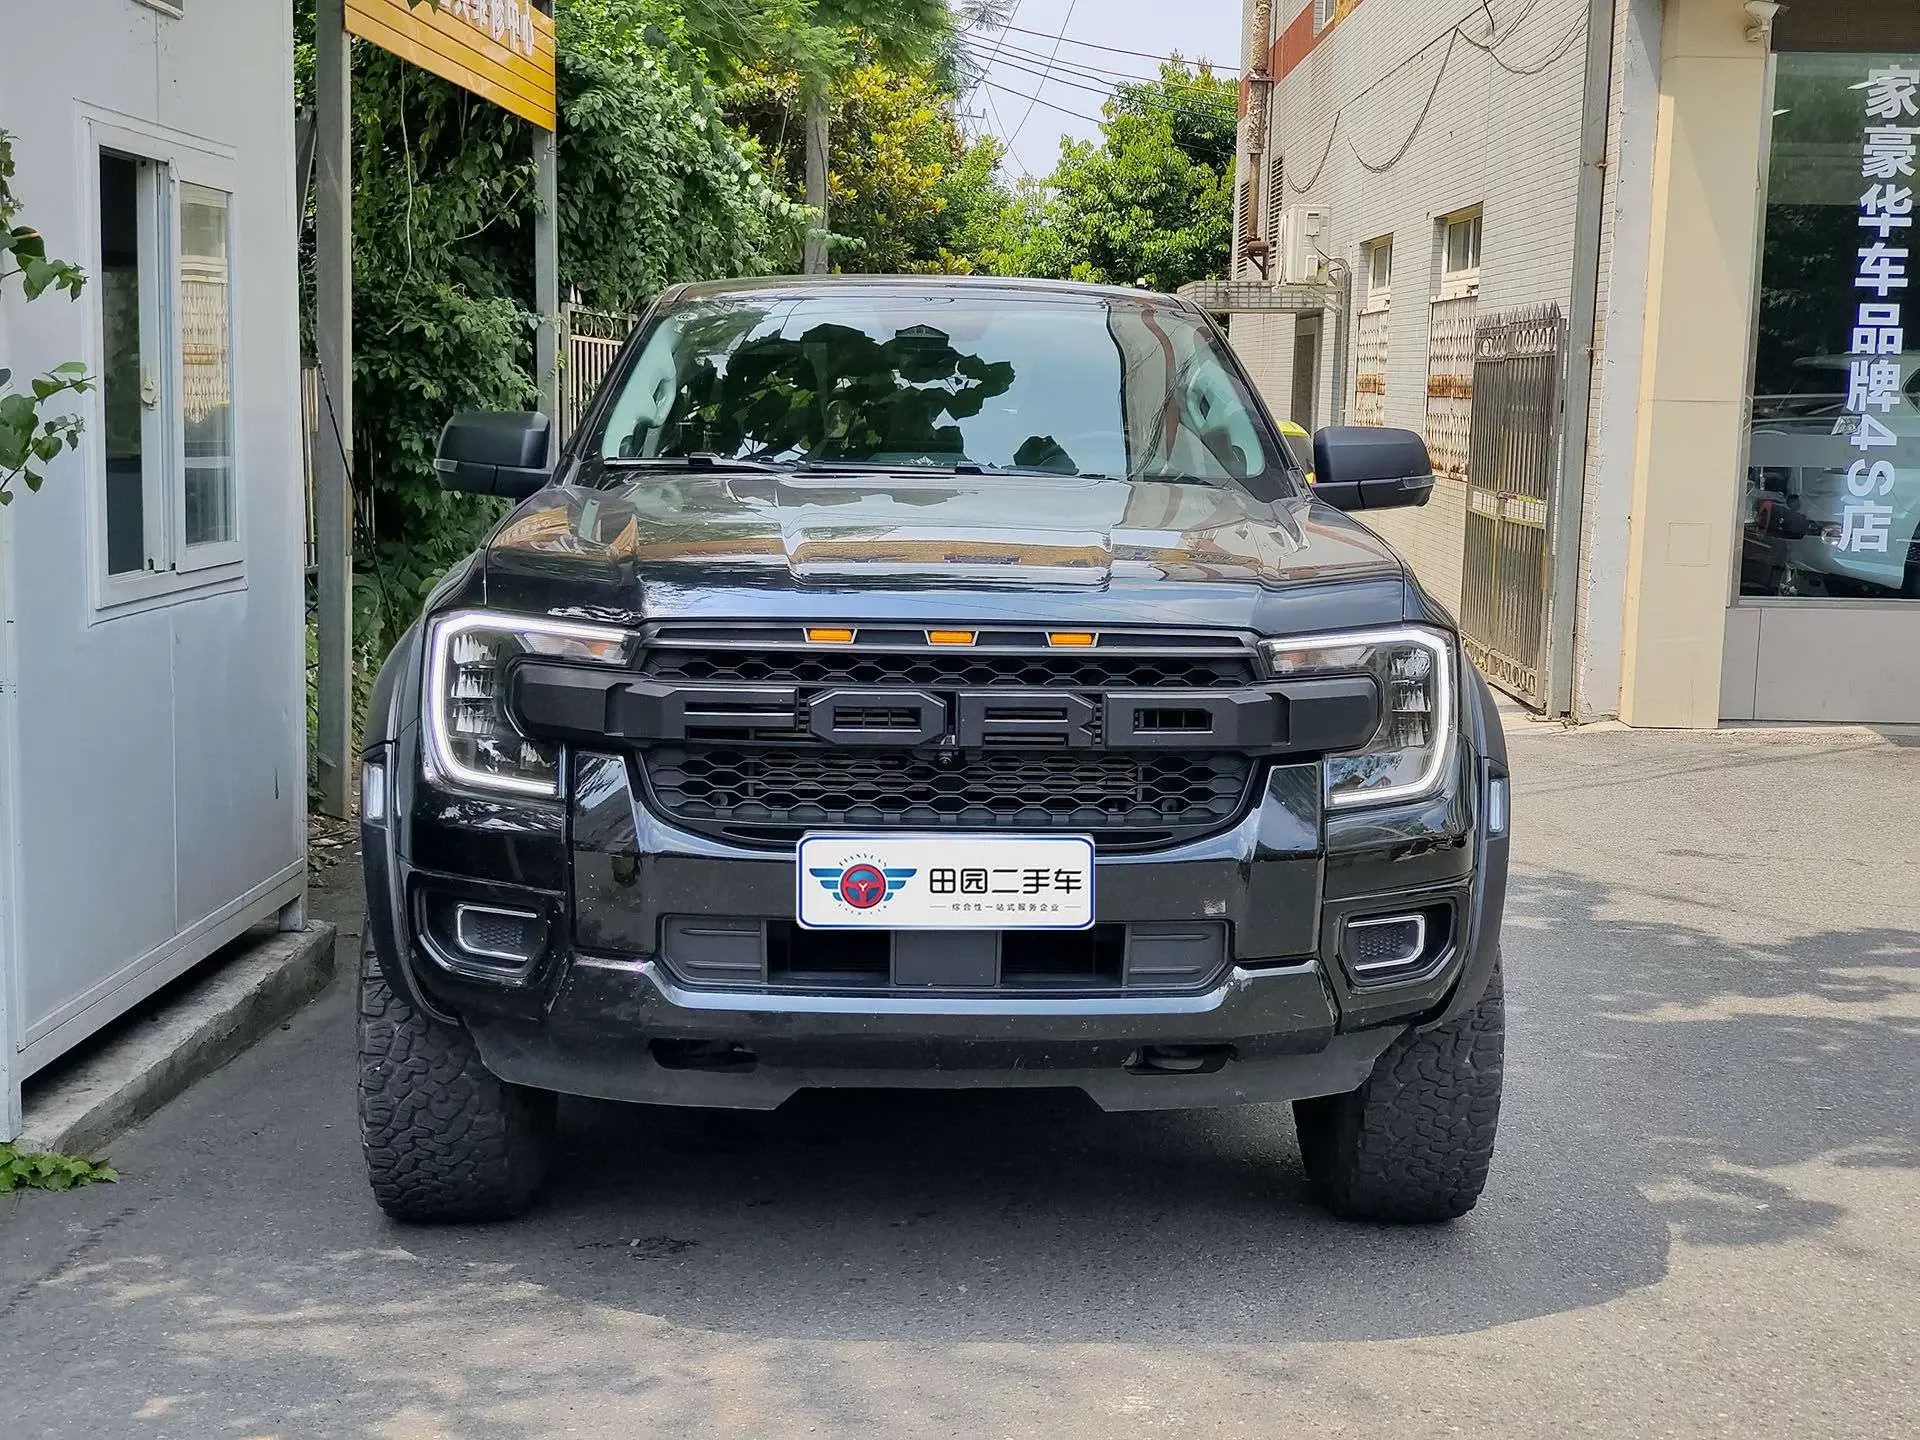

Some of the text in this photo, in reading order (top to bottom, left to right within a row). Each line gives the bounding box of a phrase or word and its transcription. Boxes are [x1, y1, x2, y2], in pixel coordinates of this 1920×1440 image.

[1838, 64, 1920, 553] 家豪华车品牌4S店
[929, 868, 1083, 894] 田园二手车
